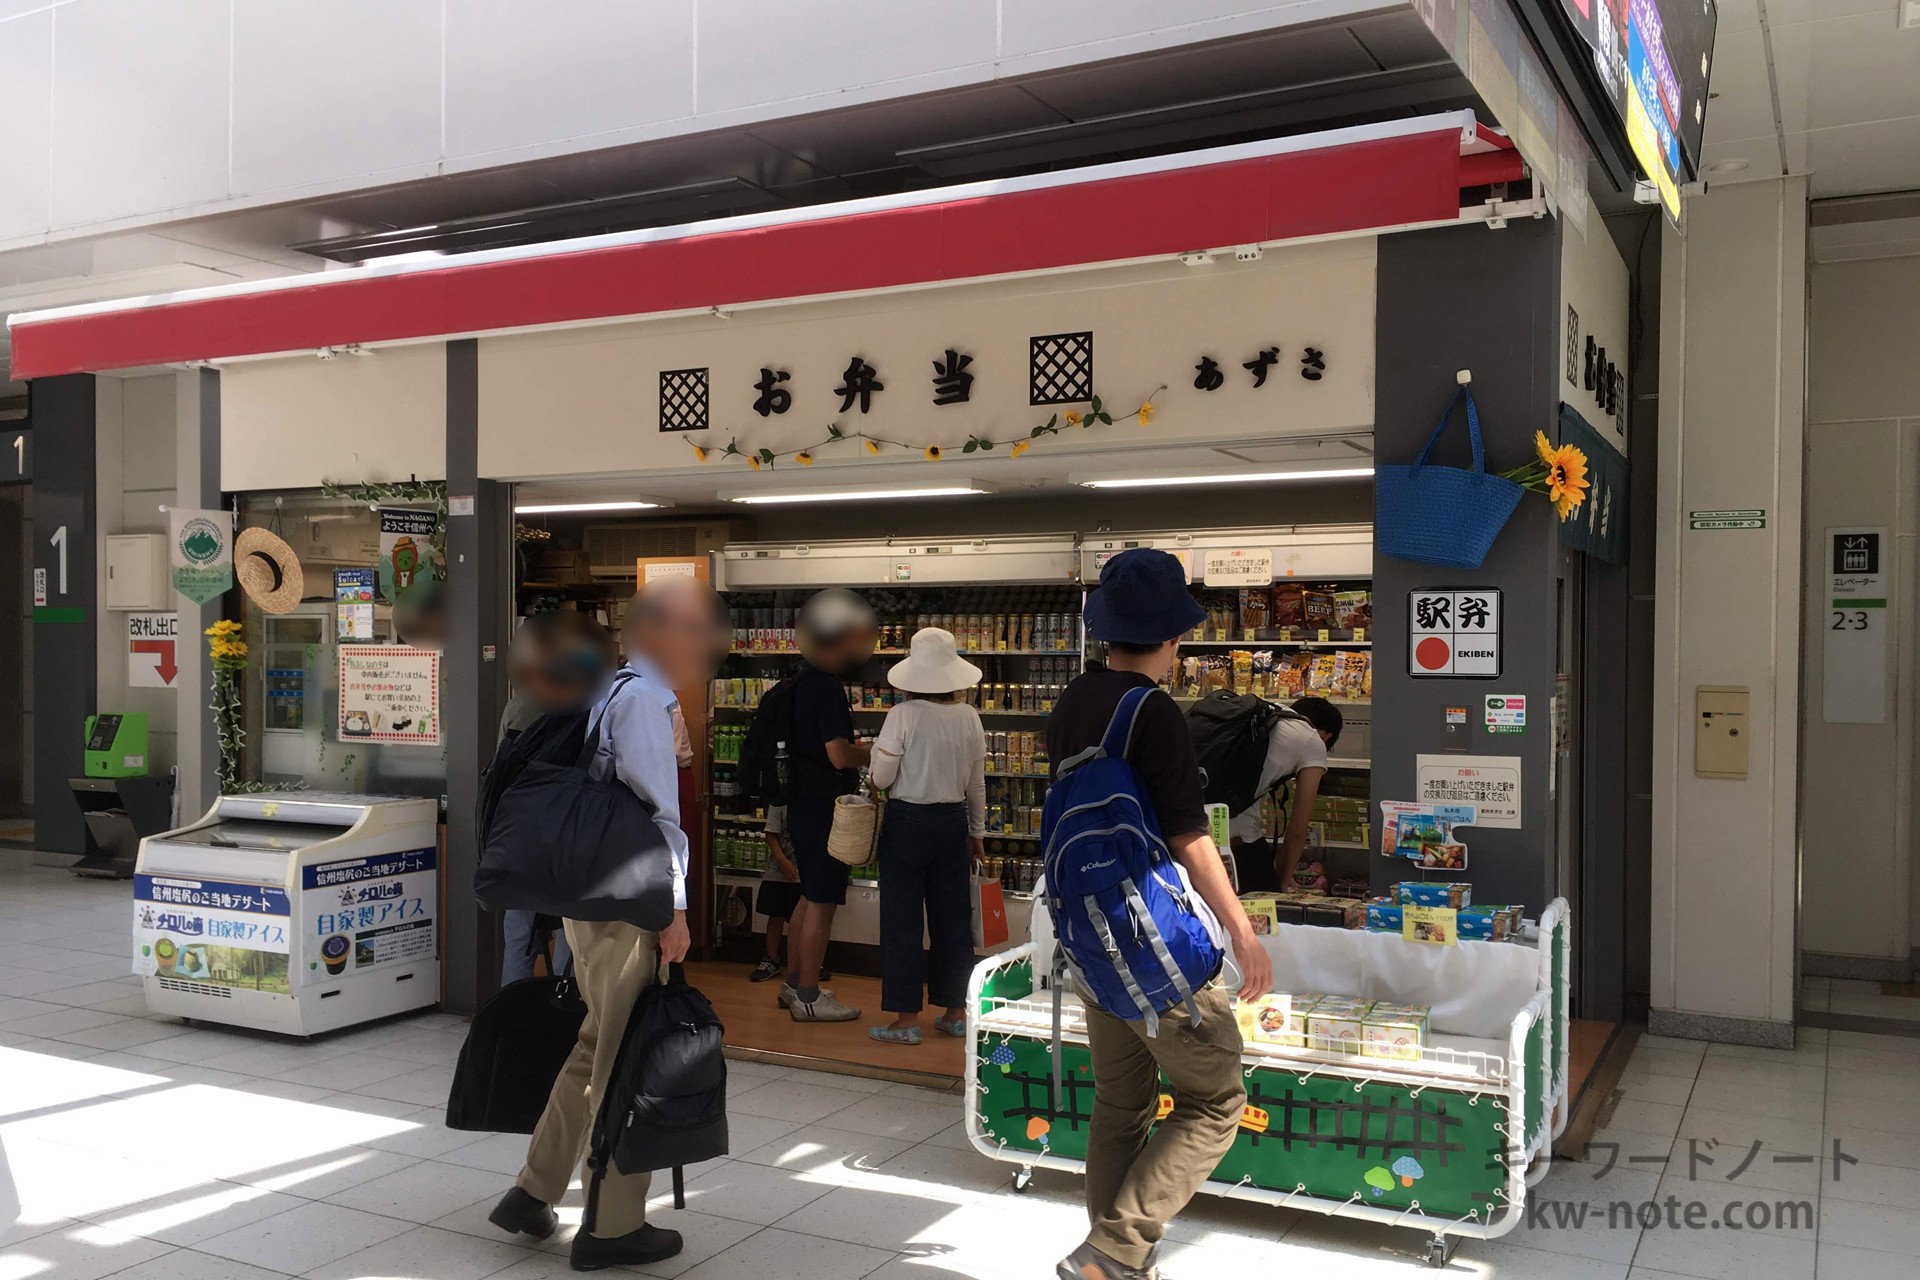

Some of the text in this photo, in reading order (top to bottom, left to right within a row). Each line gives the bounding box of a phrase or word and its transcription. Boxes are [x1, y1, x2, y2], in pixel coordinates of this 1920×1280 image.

[752, 348, 975, 418] お弁当
[1194, 347, 1327, 393] あずさ
[13, 435, 24, 475] 1
[382, 521, 435, 533] ようこそ信州へ
[50, 526, 67, 594] 1
[1833, 578, 1878, 586] エレベーター
[1307, 605, 1333, 615] BEEF
[1416, 596, 1491, 630] 駅弁
[129, 617, 178, 637] 改札出口
[1457, 650, 1495, 659] EKIBEN
[1423, 779, 1515, 792] 一度お買い上げいただきました駅弁
[1457, 768, 1480, 777] お願い
[1423, 790, 1512, 803] の交換及び返品はご遠慮ください。
[316, 858, 424, 886] 信州塩尻のご当地デザート
[152, 886, 272, 912] 信州塩尻のご当地デザート
[317, 897, 425, 936] 自家製アイス
[208, 918, 285, 944] 自家製アイス
